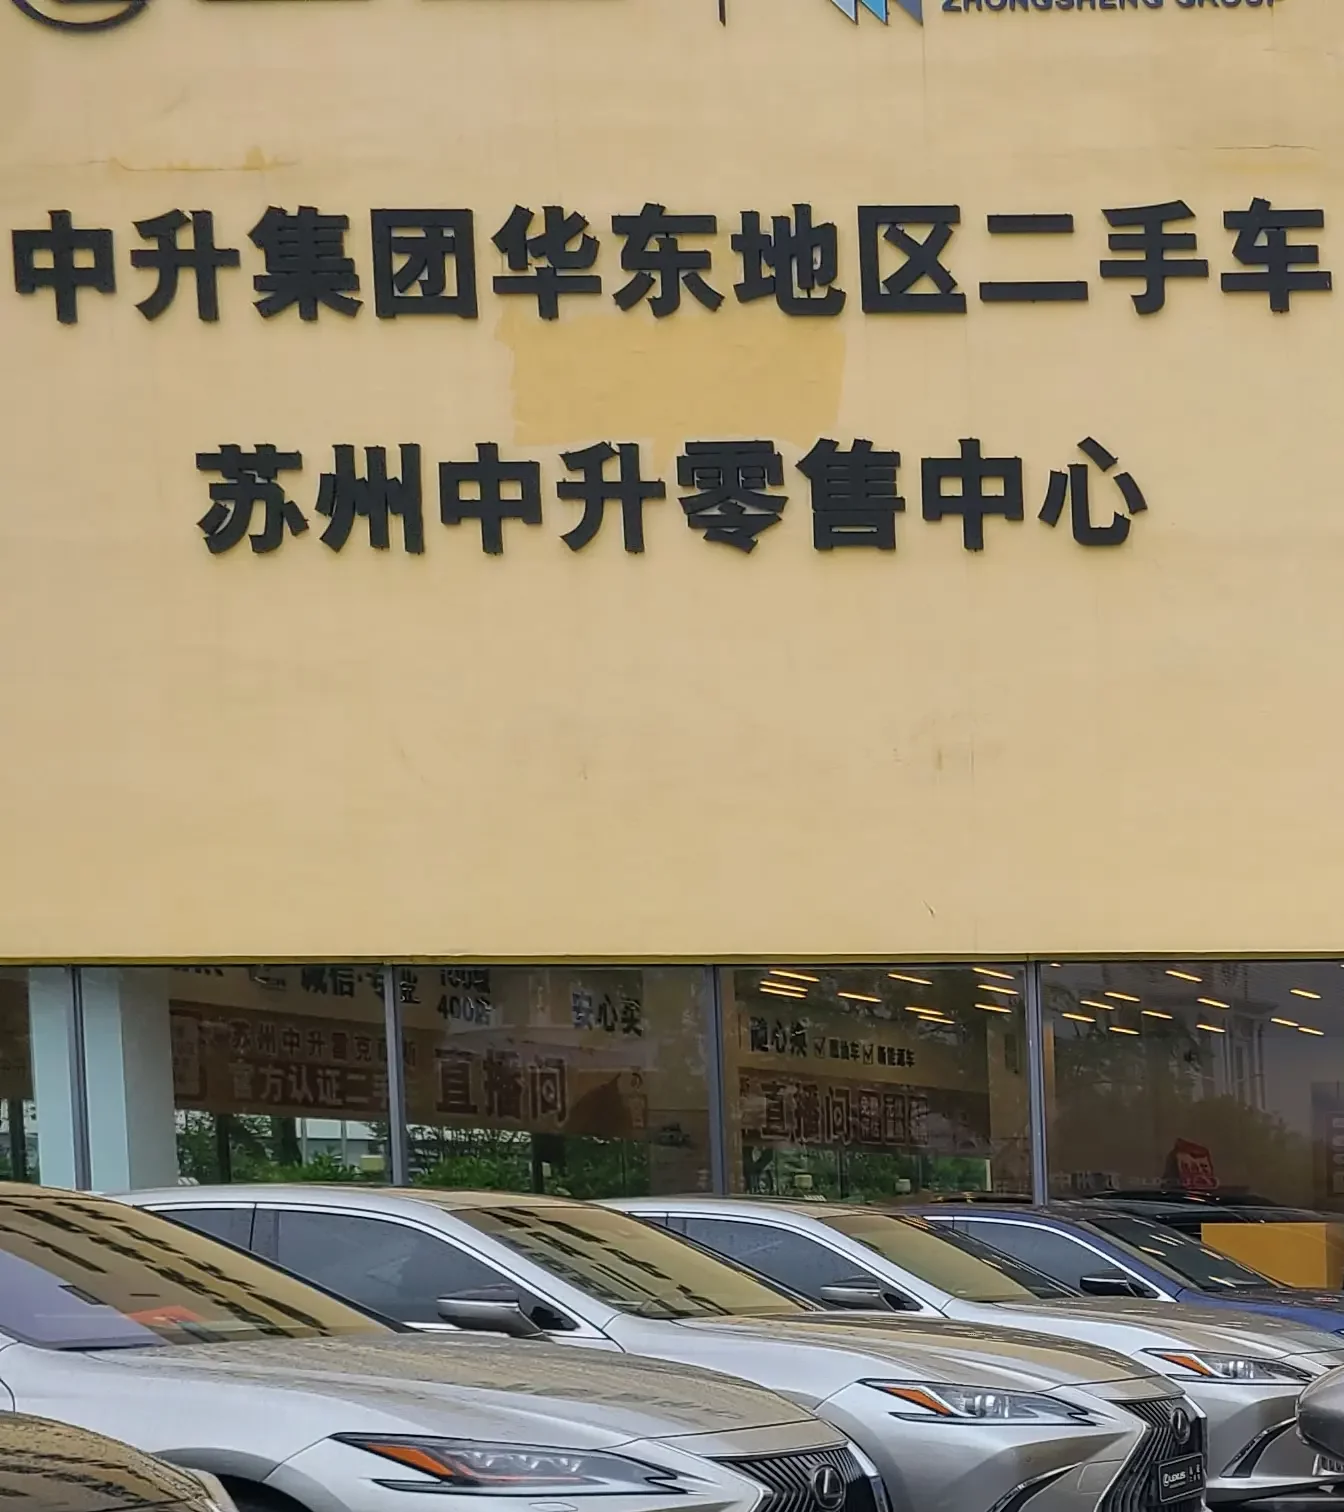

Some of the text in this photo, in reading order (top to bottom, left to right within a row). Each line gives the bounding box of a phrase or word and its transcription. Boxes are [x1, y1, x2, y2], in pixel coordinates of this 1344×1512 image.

[12, 198, 1333, 325] 中升集团华东地区二手车
[195, 436, 1148, 555] 苏州中升零售中心
